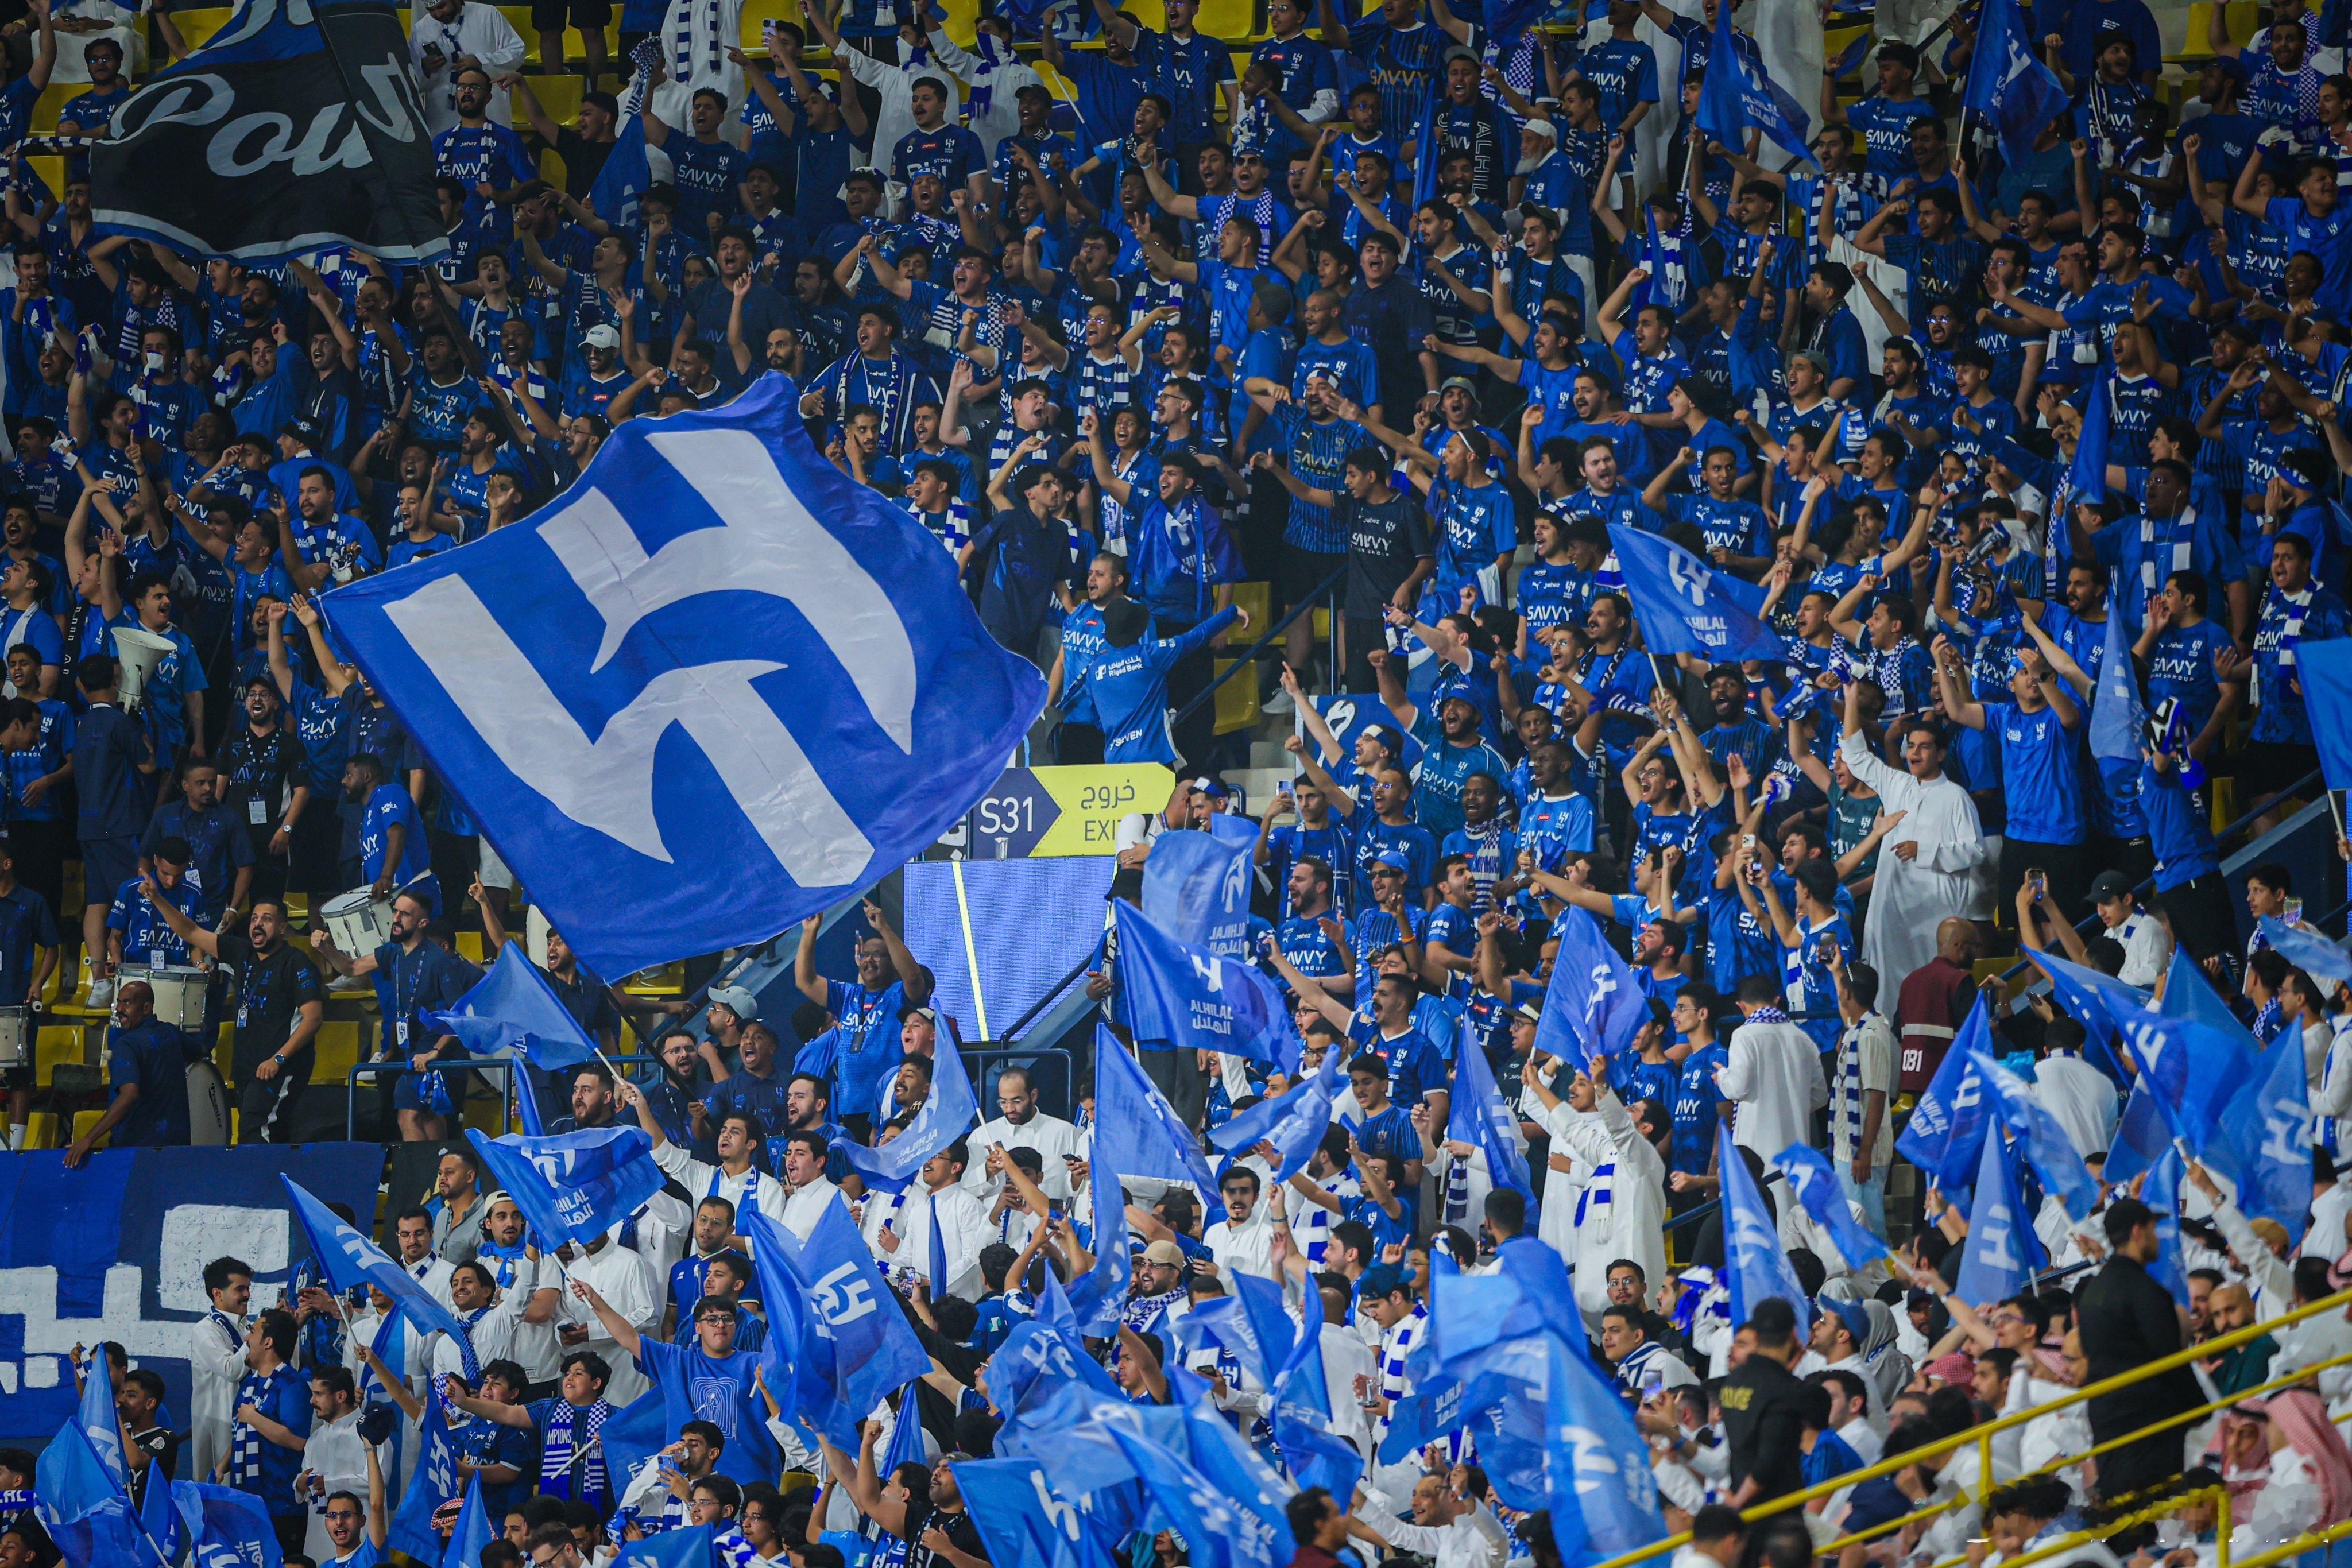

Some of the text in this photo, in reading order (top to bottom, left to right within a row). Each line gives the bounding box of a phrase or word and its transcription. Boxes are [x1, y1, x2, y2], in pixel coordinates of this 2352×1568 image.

[1370, 69, 1429, 89] SAVVY
[752, 113, 775, 129] SAV
[1866, 130, 1912, 148] SAVVY
[442, 163, 493, 176] SAVV
[678, 164, 728, 188] SAVVY
[2246, 250, 2290, 272] SAVVY
[1062, 318, 1086, 336] SAV
[1975, 334, 2008, 351] AVVY
[1703, 529, 1746, 549] AVVY
[1527, 605, 1573, 622] SAVVY
[1062, 630, 1105, 652] SAVVY
[1108, 663, 1143, 679] Riyad Bank
[1080, 779, 1136, 810] خروج
[979, 796, 1034, 834] S31
[1085, 820, 1120, 842] EXI
[1283, 950, 1328, 966] AVVY
[1190, 1000, 1234, 1021] ALHILAL
[1192, 1015, 1231, 1035] الهلال
